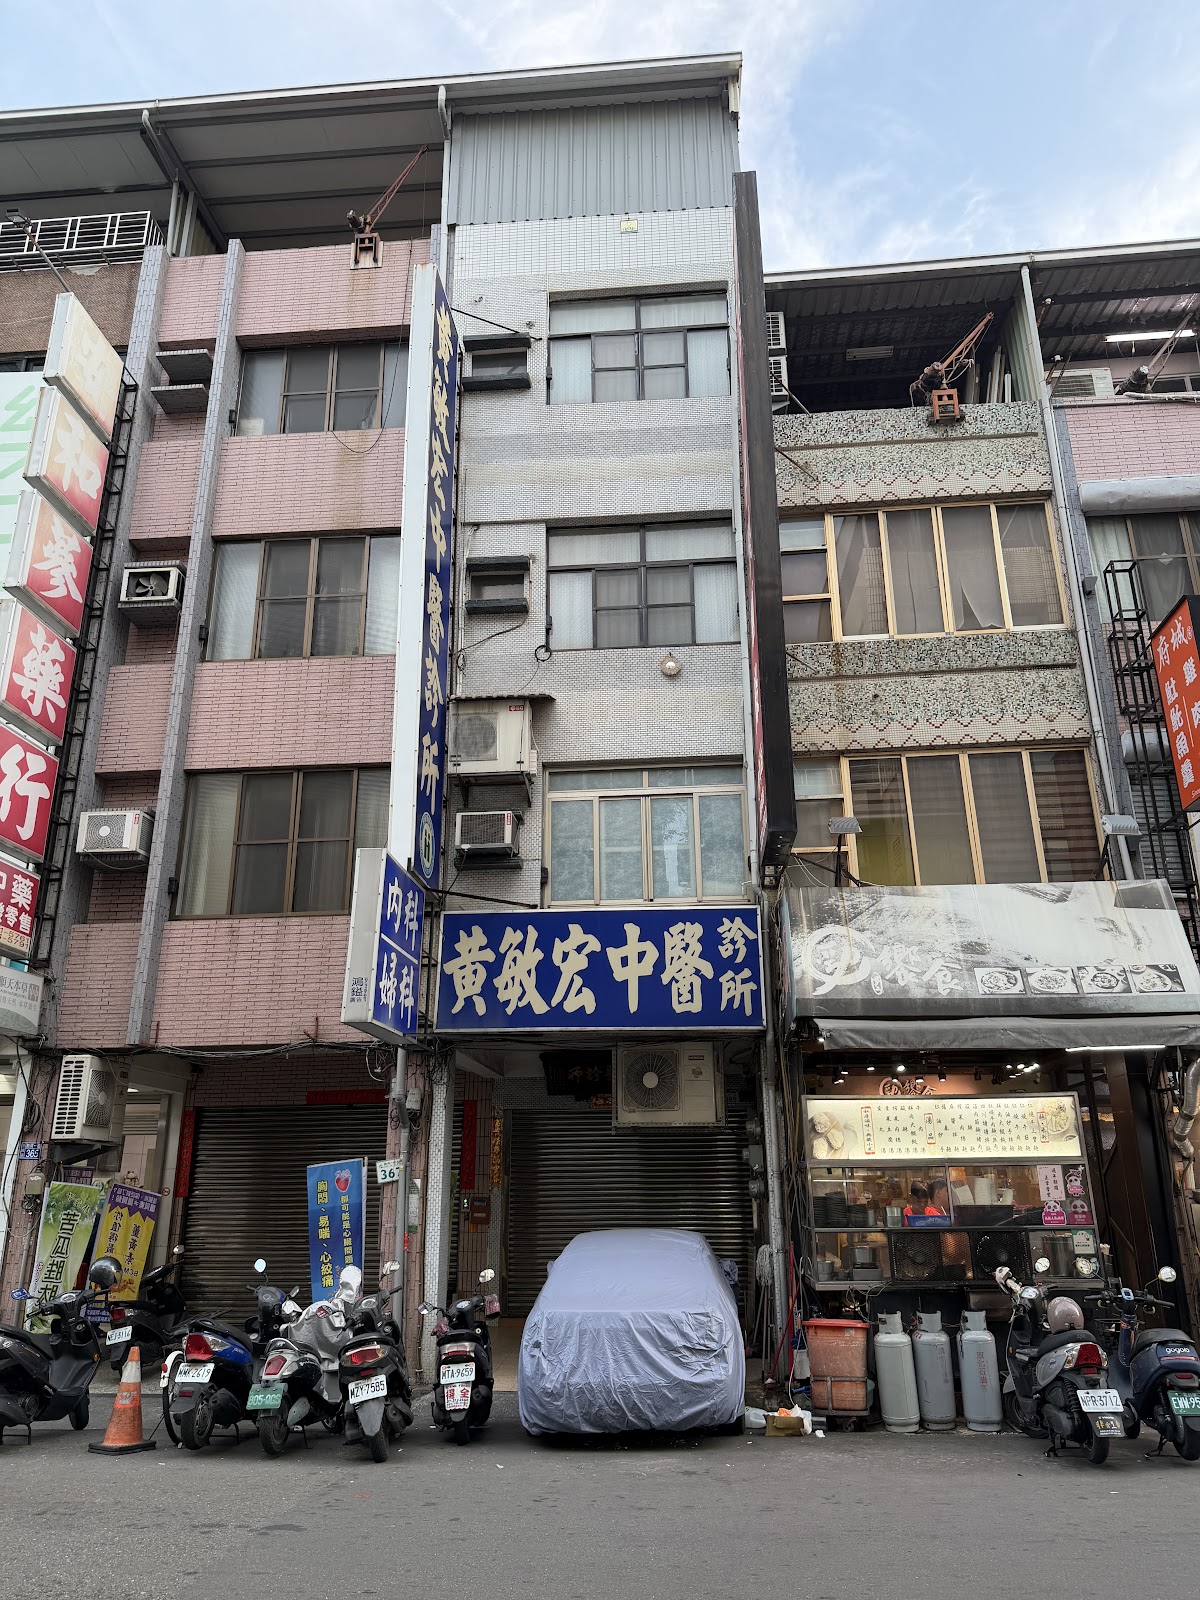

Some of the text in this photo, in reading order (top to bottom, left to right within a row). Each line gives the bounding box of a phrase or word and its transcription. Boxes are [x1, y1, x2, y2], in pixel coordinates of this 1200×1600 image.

[420, 300, 454, 815] 黃敏宏中醫診所
[1158, 616, 1188, 672] 府城
[0, 902, 32, 934] 零售
[387, 877, 419, 952] 內科
[379, 951, 415, 1029] 婦科
[316, 1180, 335, 1288] 胸悶、易喘、心絞痛
